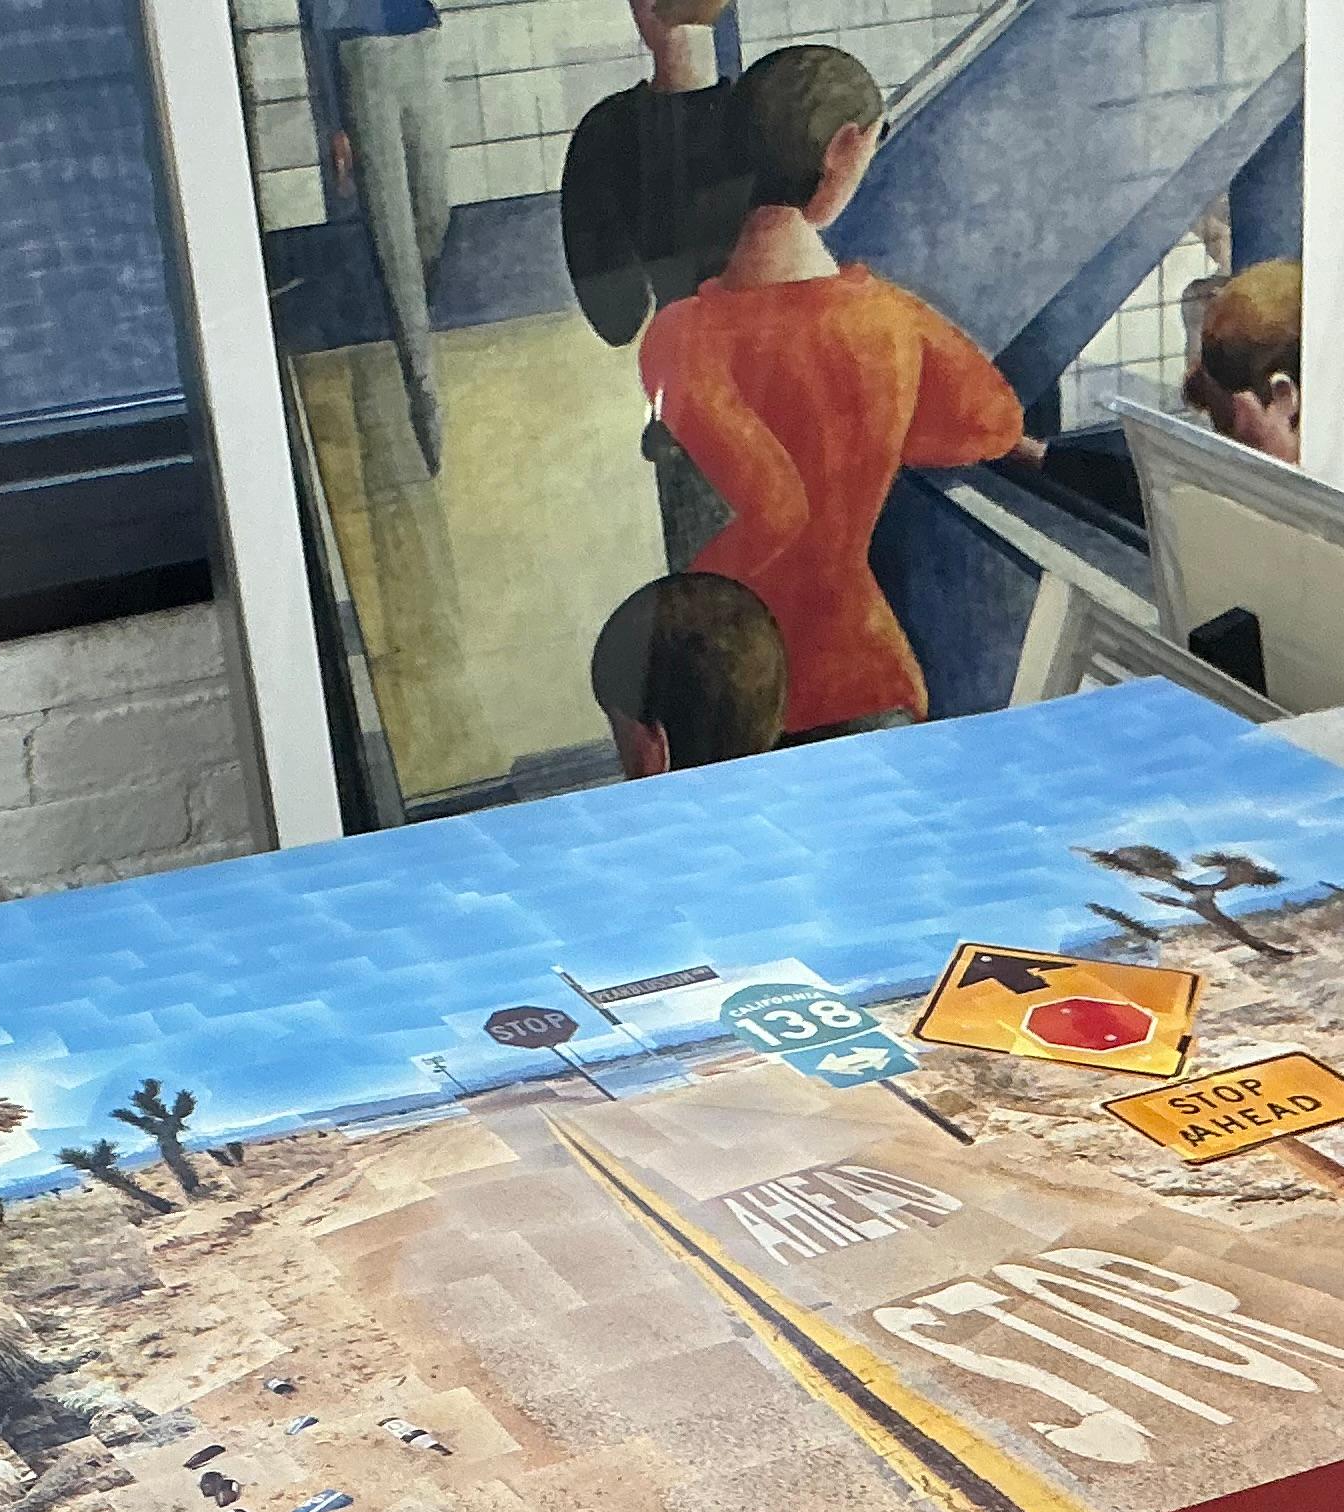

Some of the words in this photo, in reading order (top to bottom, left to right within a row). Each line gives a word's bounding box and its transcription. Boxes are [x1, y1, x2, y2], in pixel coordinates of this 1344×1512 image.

[728, 991, 825, 1018] CALIFORNIA
[734, 1000, 862, 1046] 138
[489, 1010, 565, 1042] STOP
[1168, 1079, 1262, 1114] STOP
[1179, 1095, 1322, 1147] AHEAD
[722, 1165, 963, 1266] AHEAD
